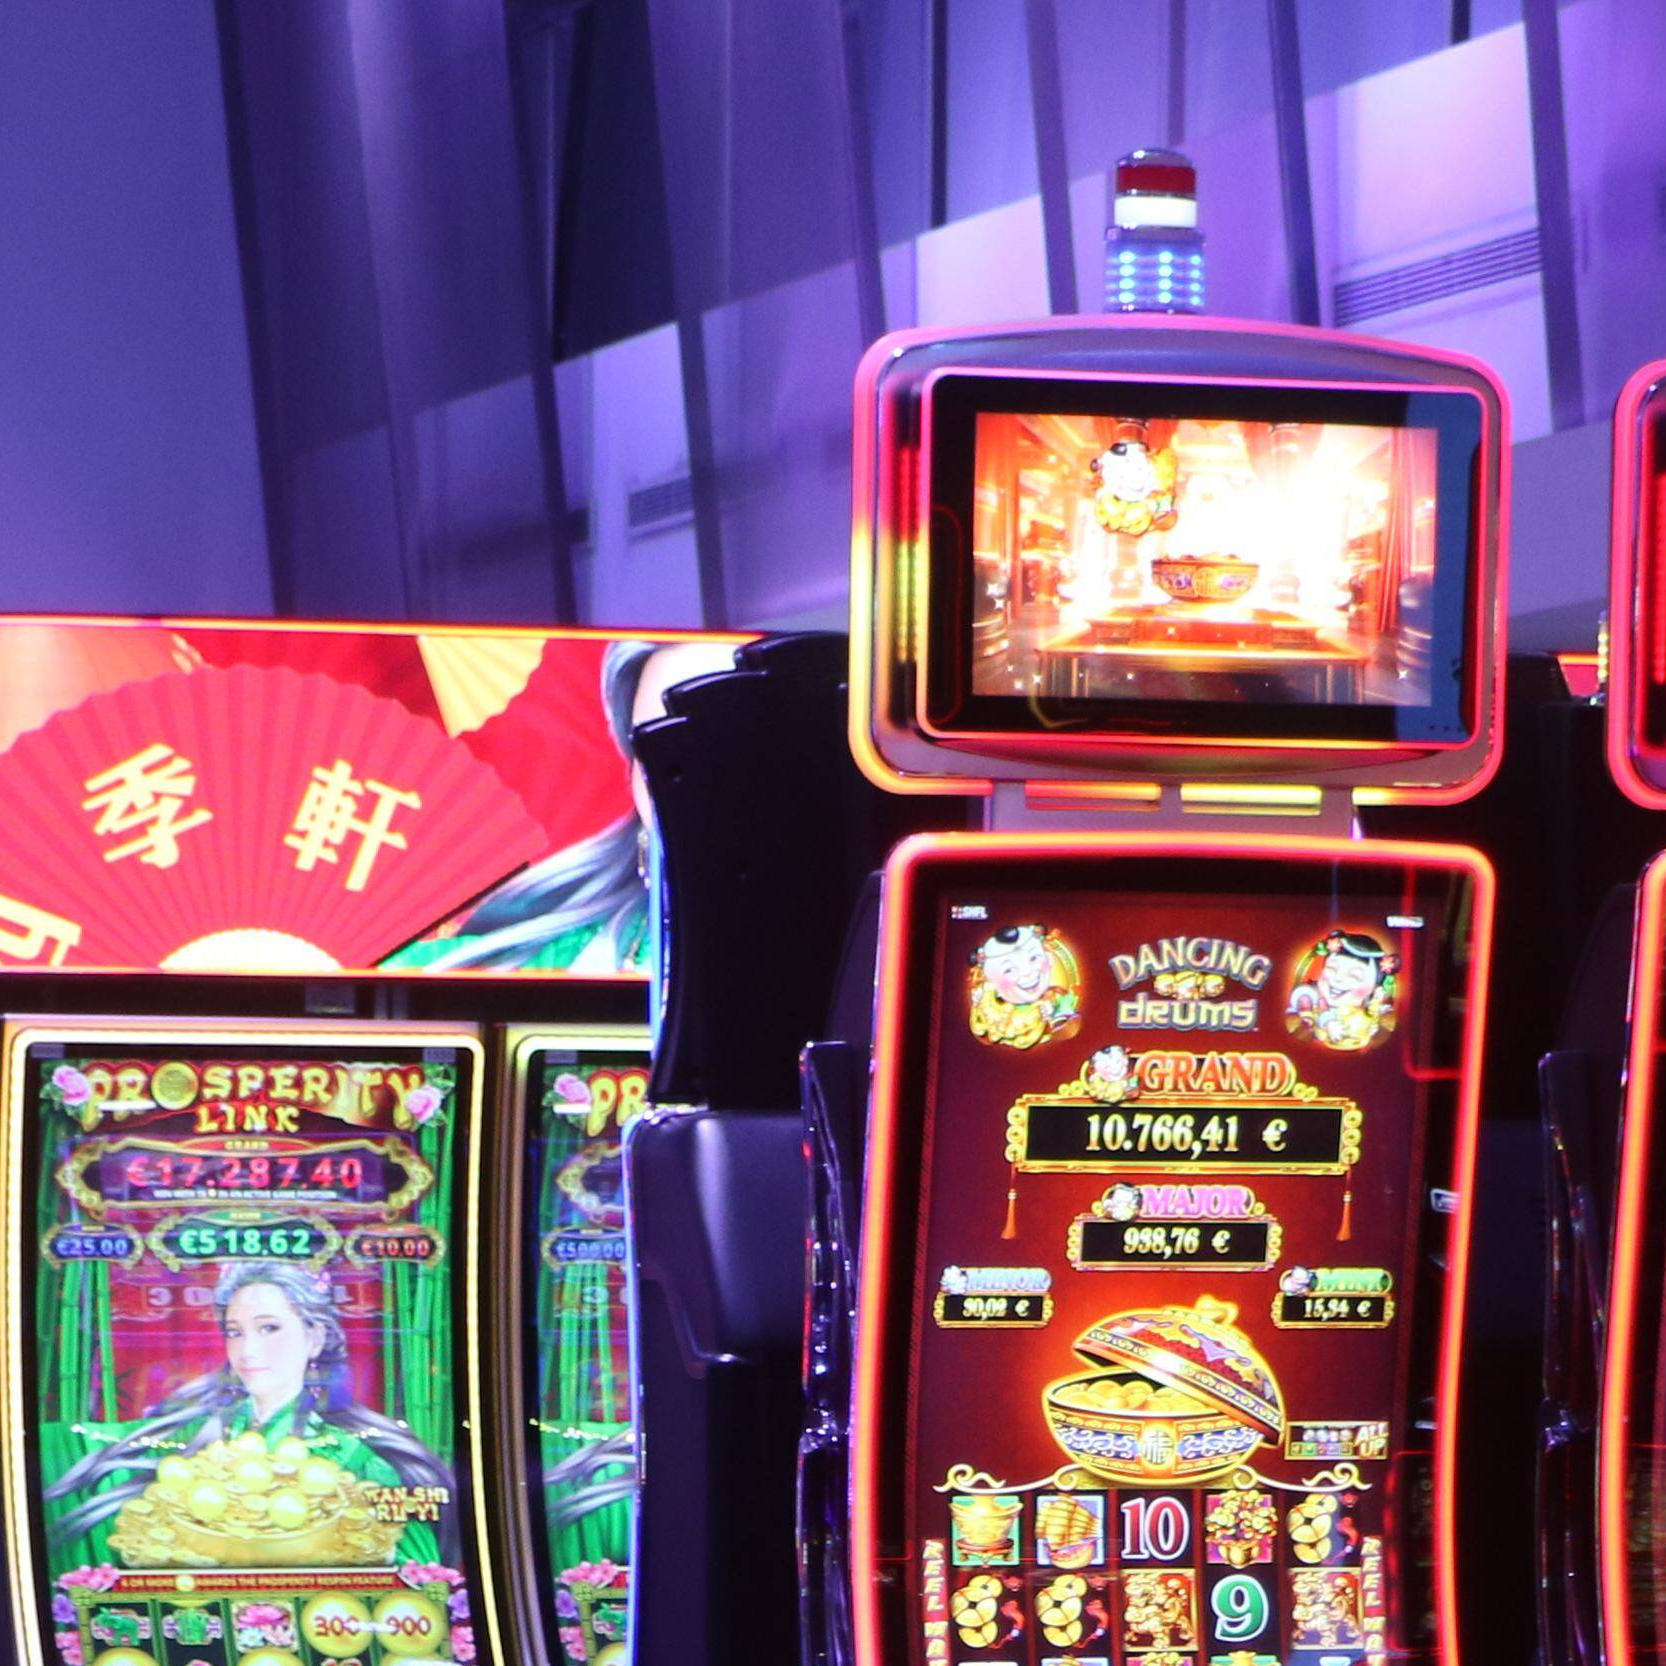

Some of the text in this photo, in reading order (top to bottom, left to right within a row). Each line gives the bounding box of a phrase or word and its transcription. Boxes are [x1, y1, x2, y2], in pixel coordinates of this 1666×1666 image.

[1109, 935, 1273, 991] DANCING
[83, 1062, 425, 1131] PROSPERITY
[1135, 1052, 1291, 1096] GRAND
[195, 1103, 302, 1134] LINK
[1084, 1113, 1287, 1160] 10.766,41 €
[1140, 1186, 1250, 1218] MAJOR
[178, 1228, 311, 1255] €518.62
[1123, 1227, 1201, 1259] 938,76
[1120, 1496, 1190, 1561] 10
[1210, 1574, 1270, 1642] 9
